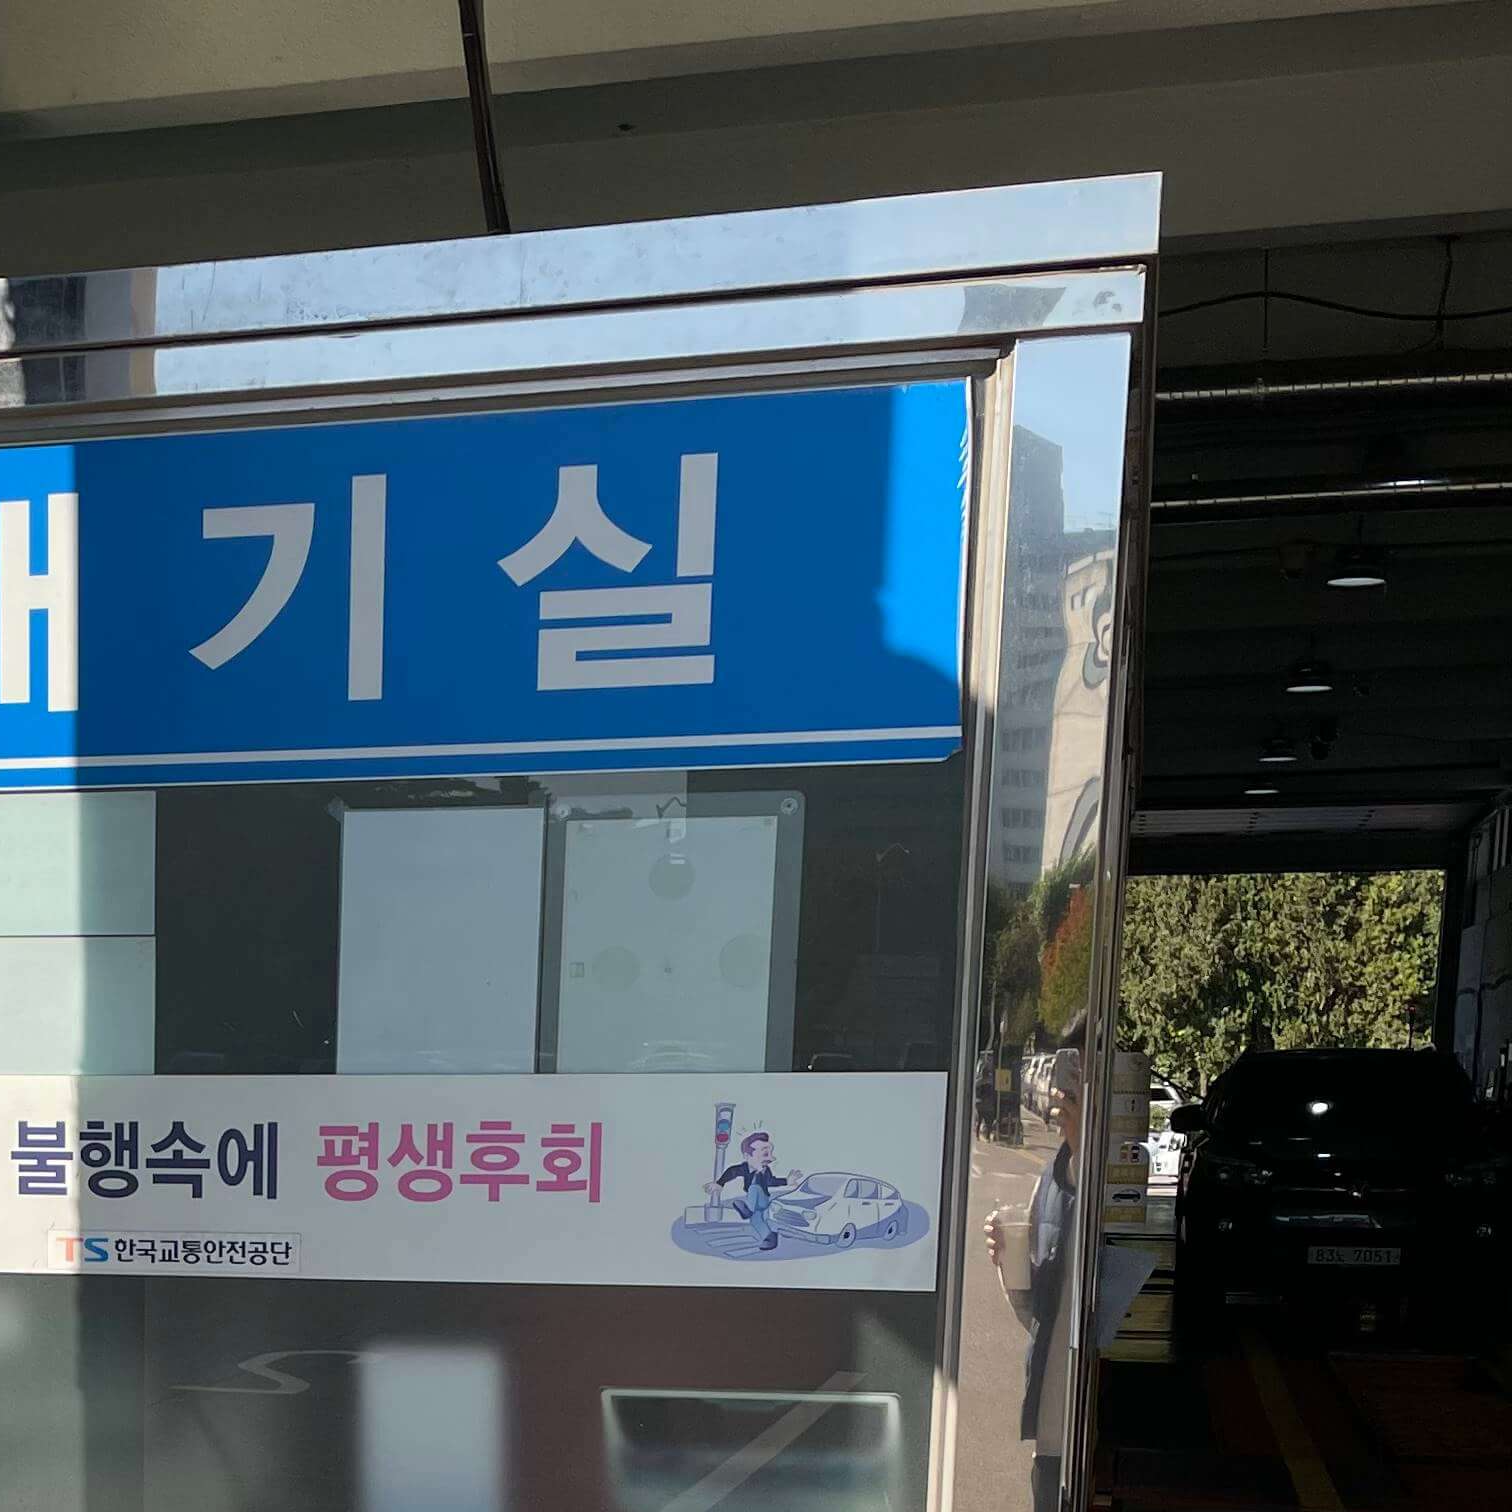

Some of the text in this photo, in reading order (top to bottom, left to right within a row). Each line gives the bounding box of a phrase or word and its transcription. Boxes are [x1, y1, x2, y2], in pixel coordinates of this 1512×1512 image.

[10, 1119, 279, 1200] 불행속에
[316, 1120, 604, 1203] 평생후회
[56, 1236, 293, 1266] TS 한국교통안전공단
